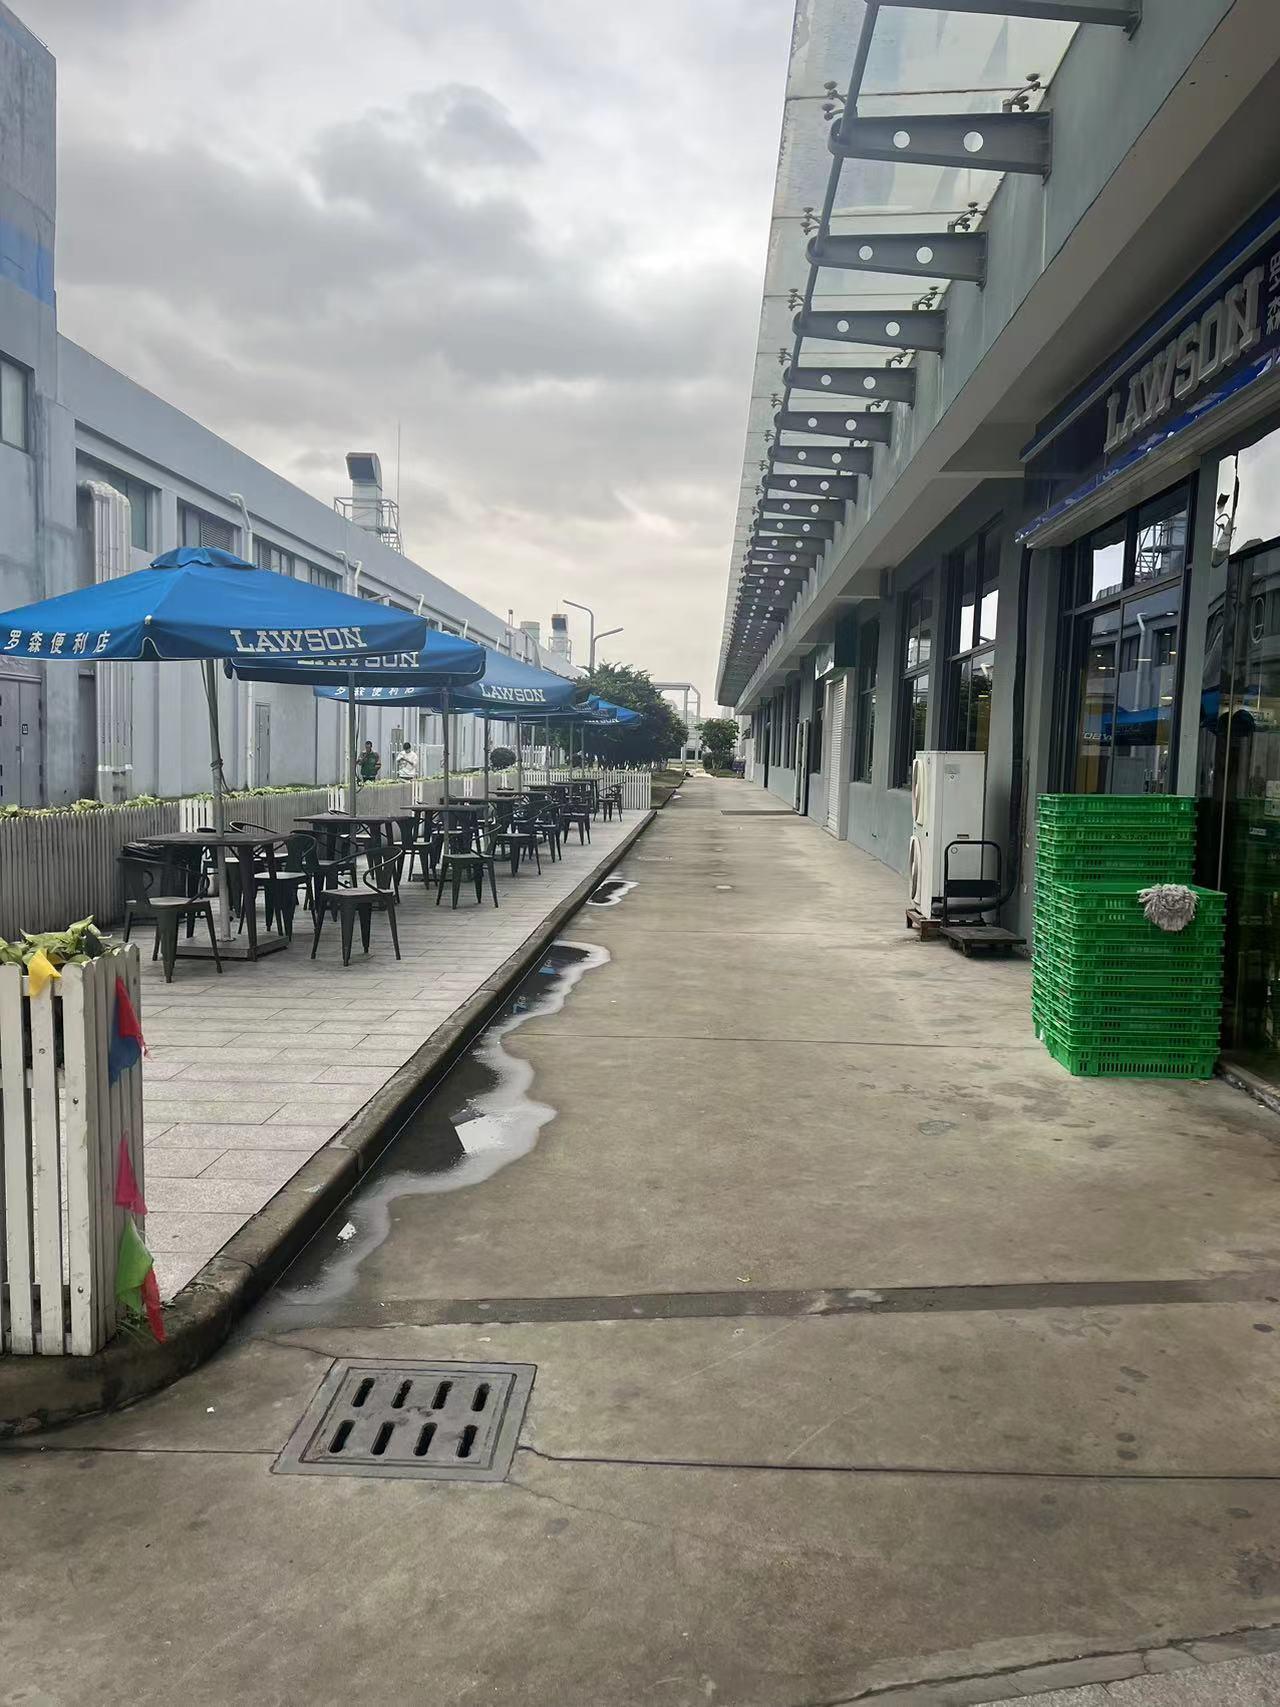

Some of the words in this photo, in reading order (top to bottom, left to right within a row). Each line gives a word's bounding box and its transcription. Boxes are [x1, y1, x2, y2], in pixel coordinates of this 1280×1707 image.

[1104, 265, 1265, 452] LAWSON
[4, 629, 111, 655] 罗森便利店
[230, 626, 367, 653] LAWSON
[479, 683, 546, 702] LAWSON
